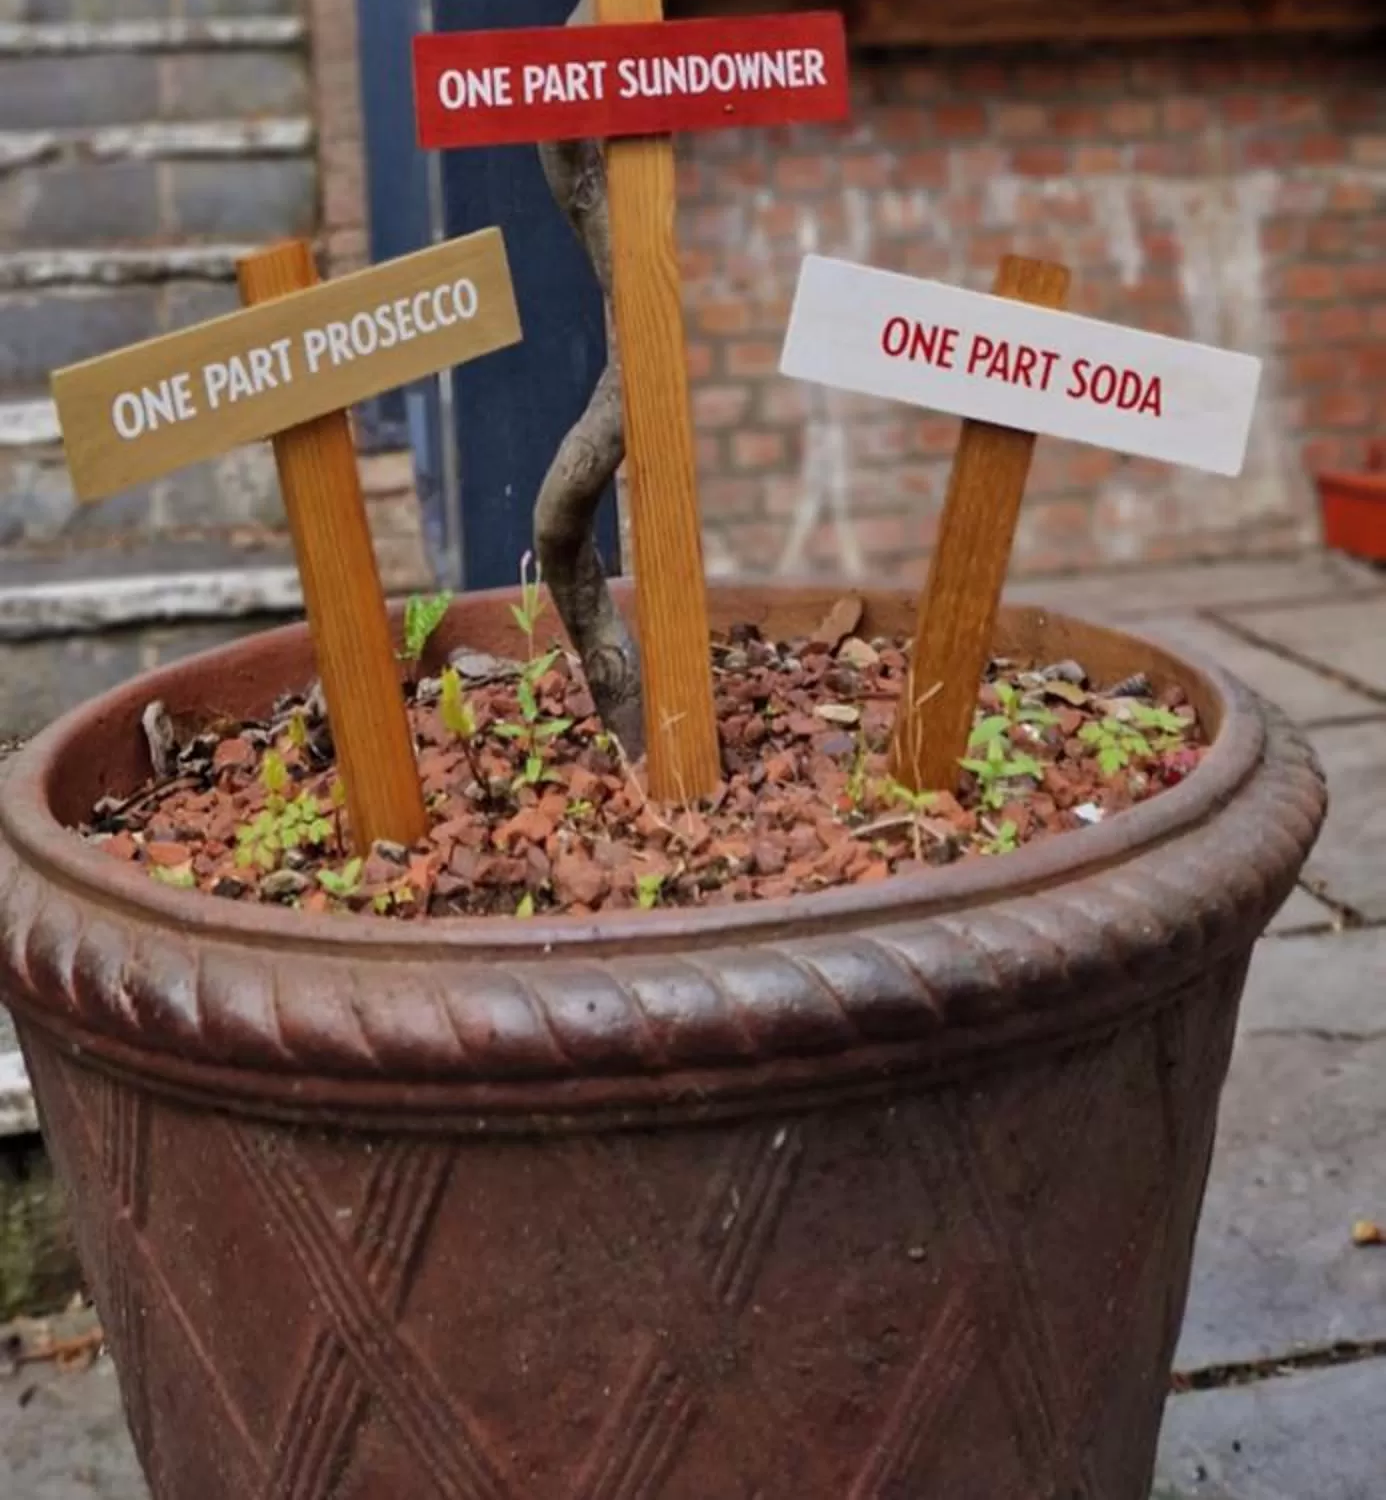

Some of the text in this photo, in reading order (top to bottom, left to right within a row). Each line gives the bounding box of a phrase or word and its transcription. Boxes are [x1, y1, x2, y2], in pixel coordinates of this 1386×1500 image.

[438, 47, 827, 110] ONE PART SUNDOWNER
[112, 277, 478, 439] ONE PART PROSECCO
[881, 315, 1163, 417] ONE PART SODA
